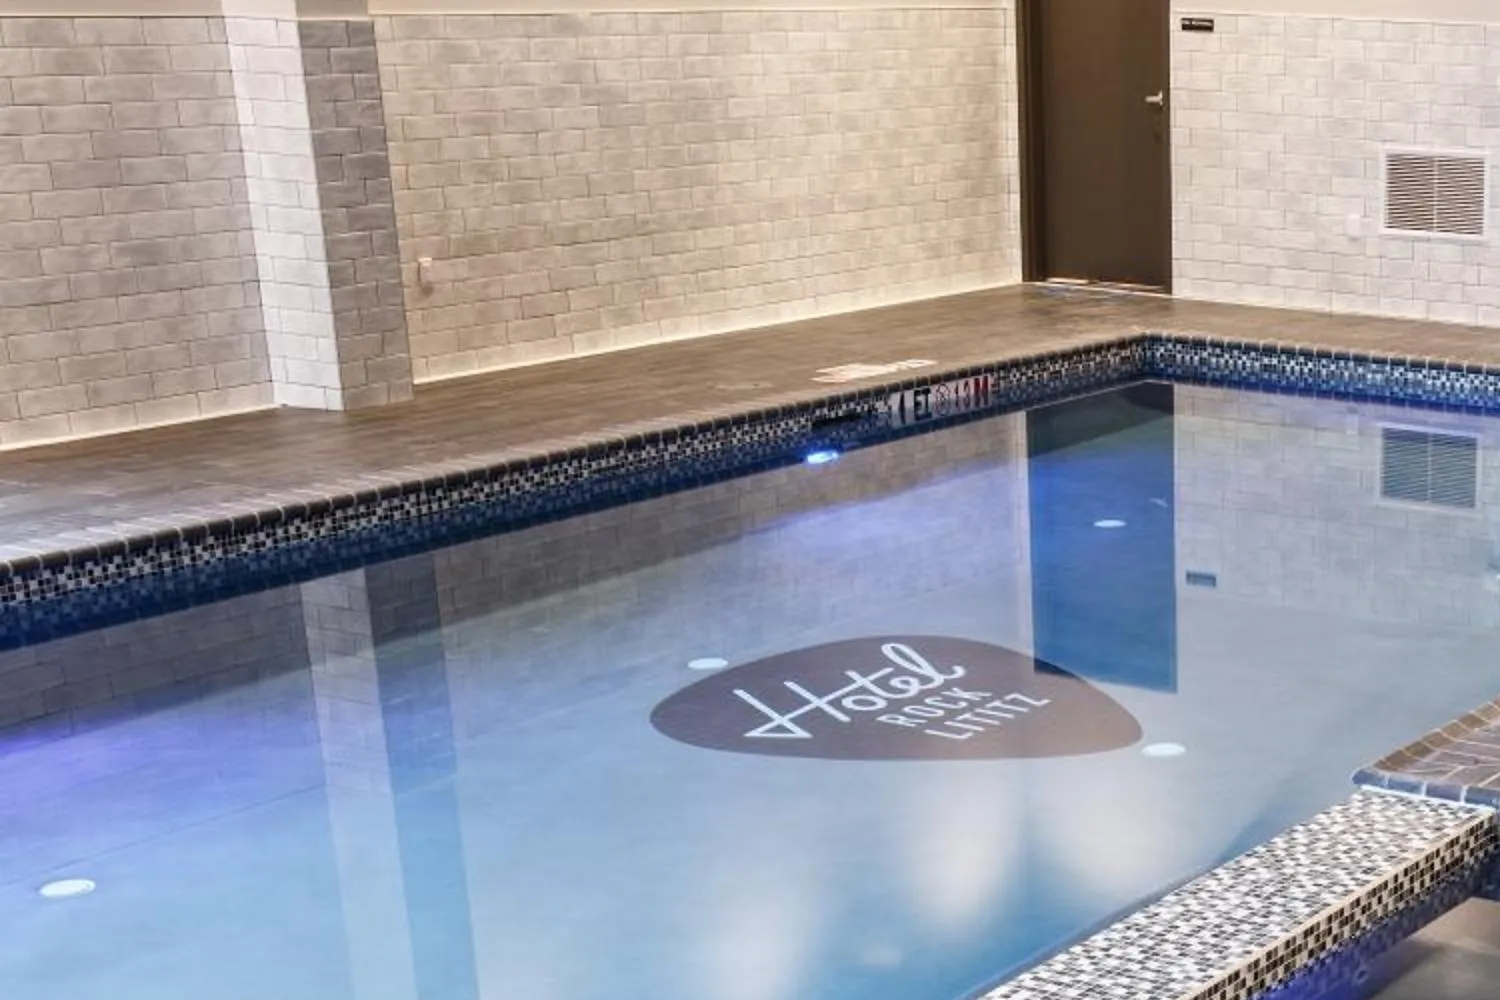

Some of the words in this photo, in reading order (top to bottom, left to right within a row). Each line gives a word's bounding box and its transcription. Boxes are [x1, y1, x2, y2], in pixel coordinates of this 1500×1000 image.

[733, 643, 967, 738] Hotel
[876, 687, 993, 727] ROCK
[924, 692, 1052, 740] LITITZ
